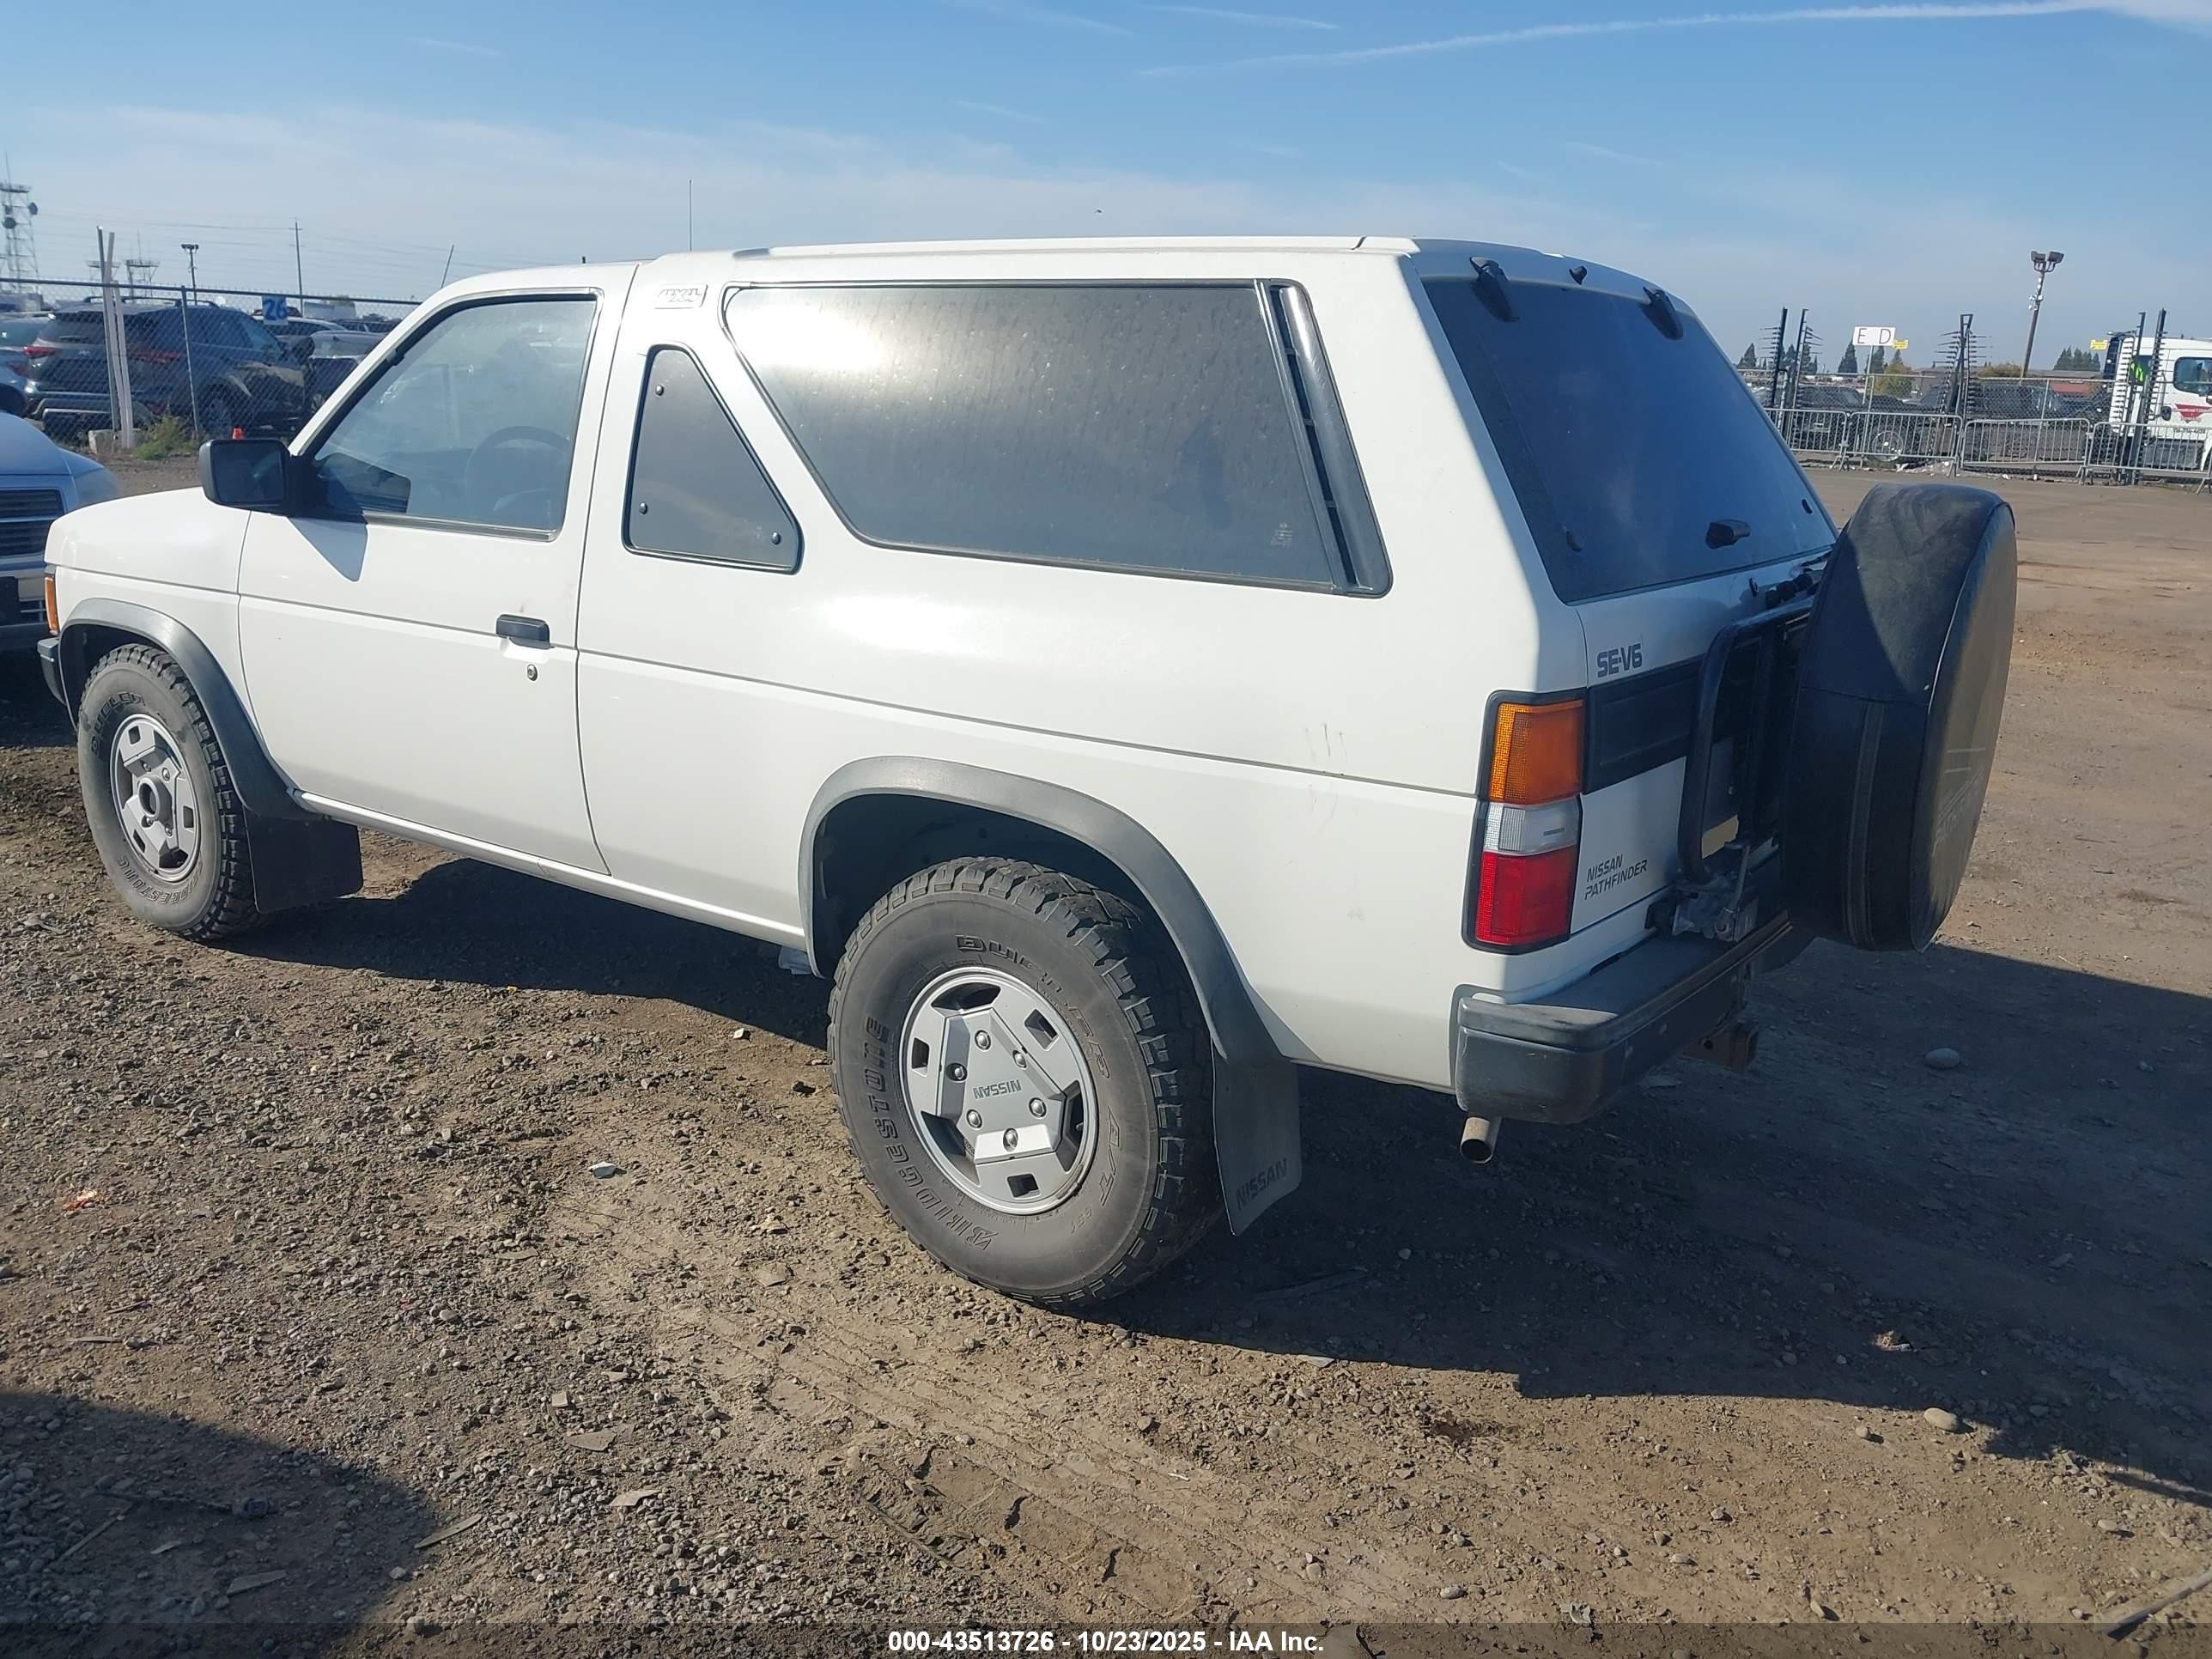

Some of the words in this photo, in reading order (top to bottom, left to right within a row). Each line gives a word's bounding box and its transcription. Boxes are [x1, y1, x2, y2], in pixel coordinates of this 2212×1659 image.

[265, 299, 288, 320] 26
[1856, 327, 1867, 344] E
[1879, 328, 1892, 344] D
[1584, 859, 1648, 901] PATHFINDER
[1587, 854, 1623, 883] NISSAN
[973, 1079, 1022, 1099] NISSAN
[866, 1016, 998, 1251] BRIDGESTONE
[1237, 1158, 1287, 1211] NISSAN
